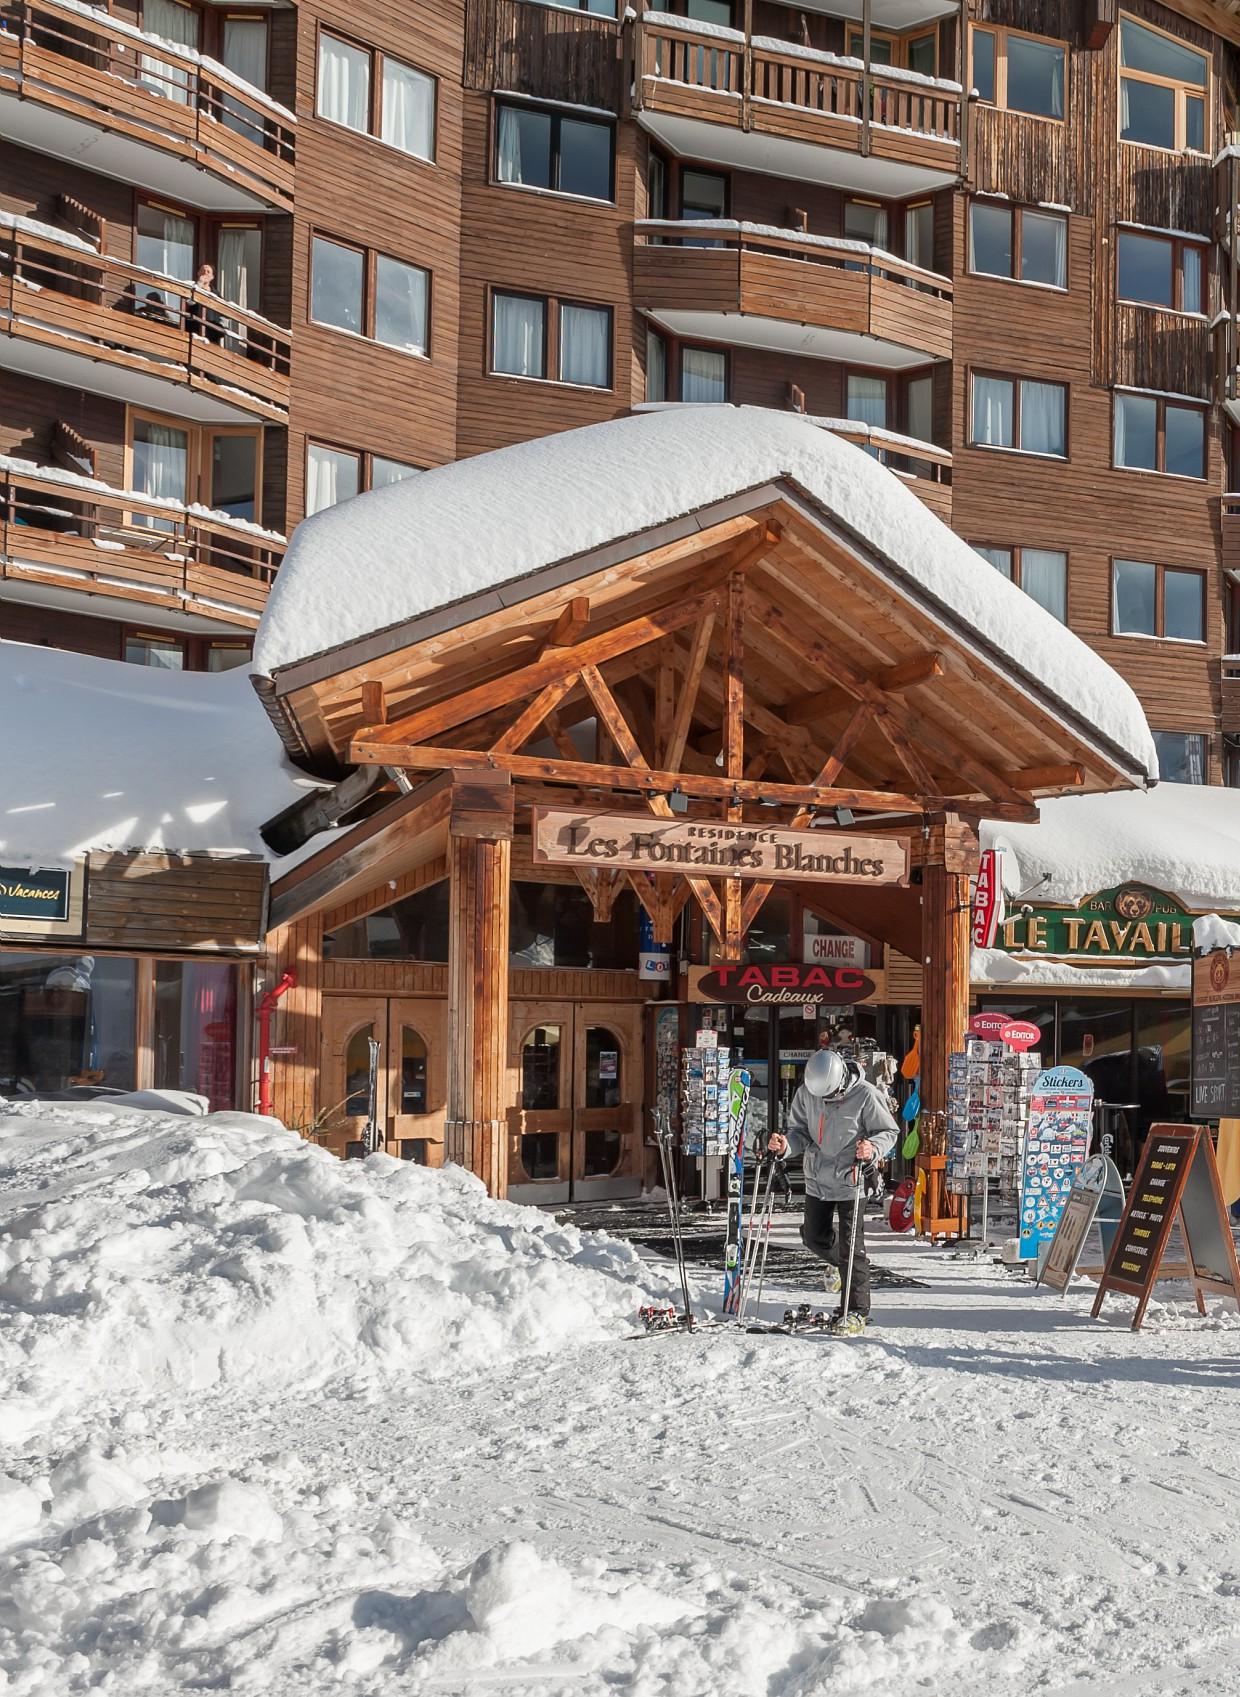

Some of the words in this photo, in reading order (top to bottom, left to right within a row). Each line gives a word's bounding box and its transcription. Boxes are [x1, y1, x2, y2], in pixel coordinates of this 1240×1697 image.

[687, 826, 778, 844] RESIDENCE
[566, 827, 618, 858] Les
[630, 832, 763, 869] Fontaines
[774, 844, 884, 877] Blanches
[8, 883, 61, 900] Vacances
[973, 853, 991, 944] TABAC
[1090, 901, 1112, 913] BAR
[1155, 903, 1177, 915] PUB
[1004, 916, 1047, 950] LE
[812, 938, 856, 959] CHANGE
[711, 965, 865, 989] TABAC
[746, 984, 824, 1004] Cadeaux
[1042, 1075, 1083, 1088] Stickers
